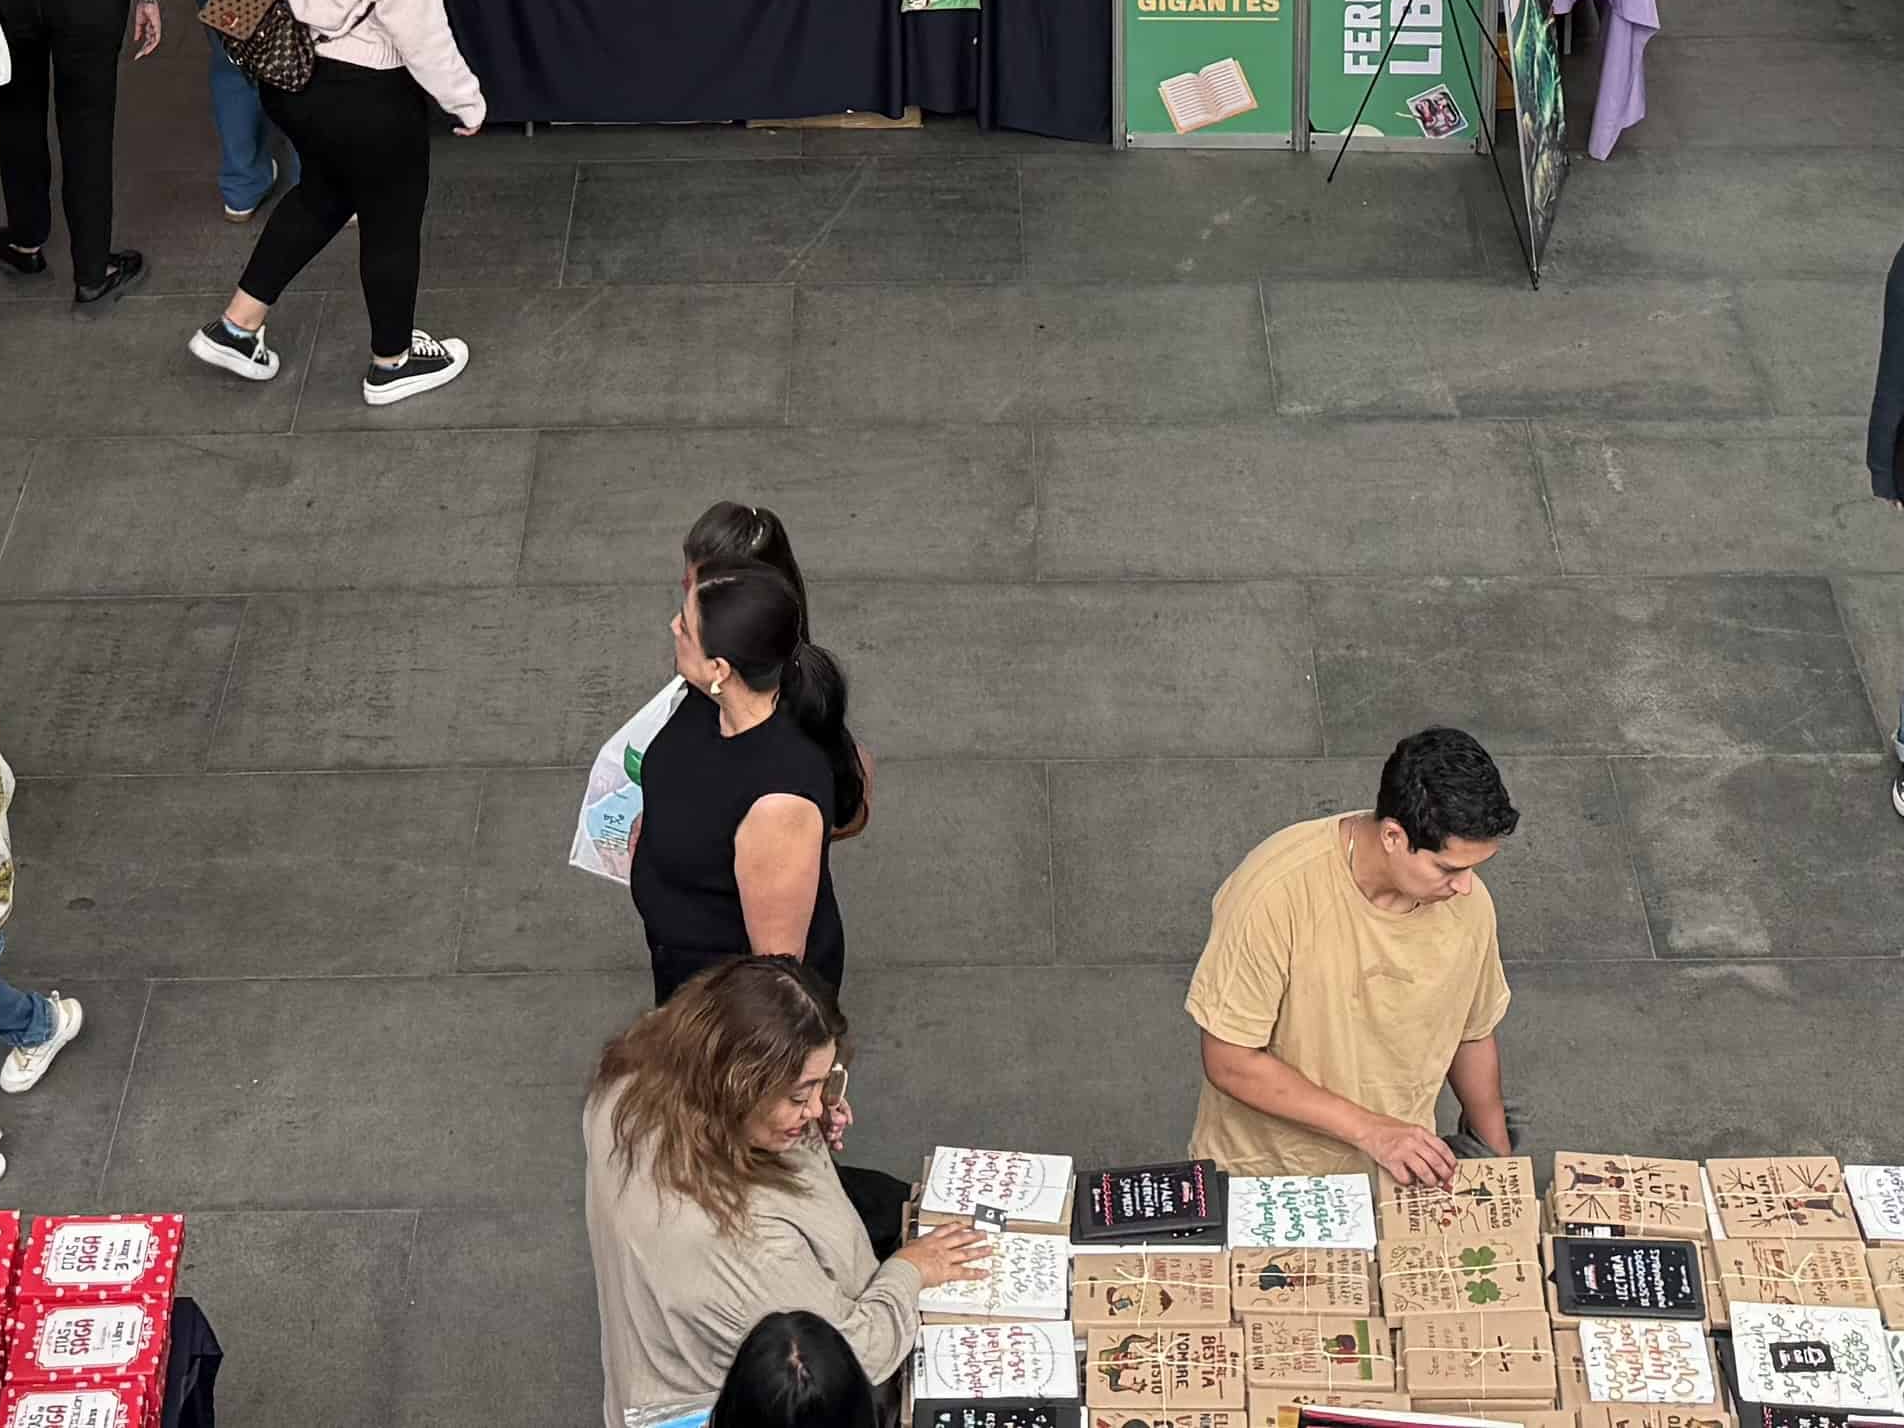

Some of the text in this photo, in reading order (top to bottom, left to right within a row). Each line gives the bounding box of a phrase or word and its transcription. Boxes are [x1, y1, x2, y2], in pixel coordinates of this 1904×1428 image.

[61, 1245, 79, 1271] CITAS
[75, 1235, 103, 1273] SAGA
[54, 1327, 72, 1355] CITAS
[68, 1318, 95, 1356] SAGA
[1201, 1335, 1217, 1389] BESTIA
